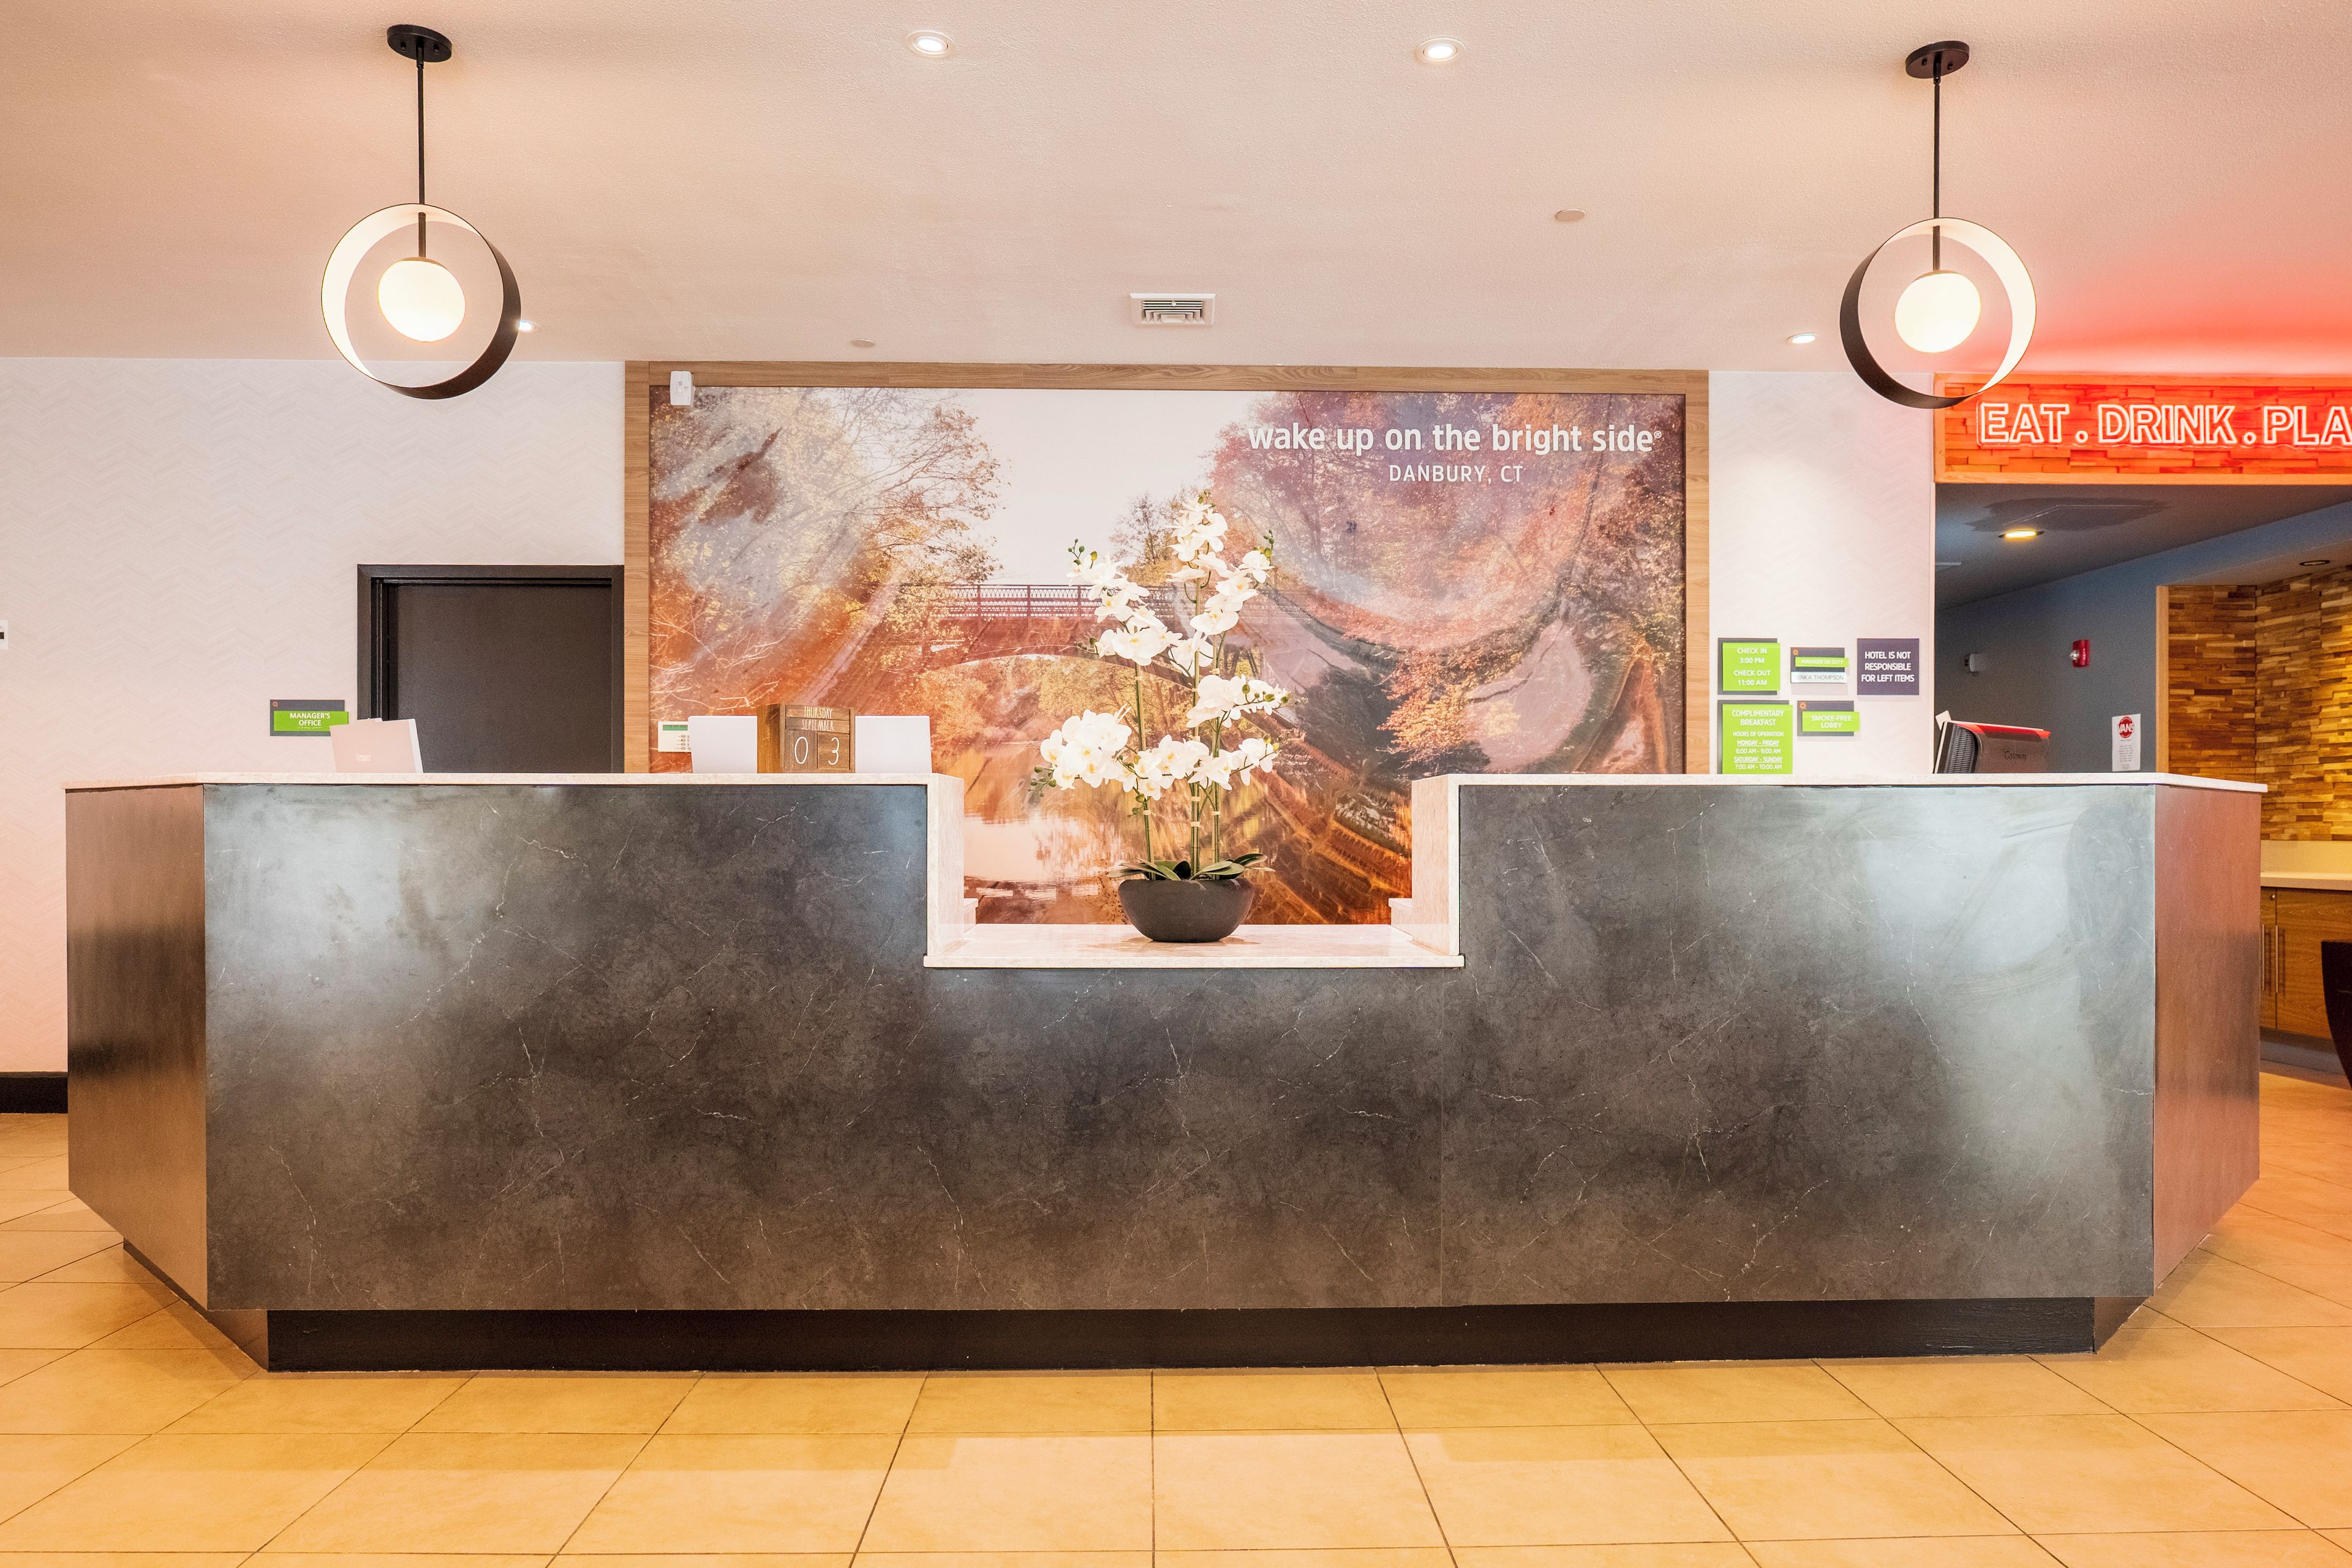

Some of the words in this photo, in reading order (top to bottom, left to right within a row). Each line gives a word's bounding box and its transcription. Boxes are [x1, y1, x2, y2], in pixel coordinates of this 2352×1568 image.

[1248, 422, 1325, 450] wake
[1337, 428, 1374, 456] up
[1385, 428, 1422, 451] on
[1432, 423, 1480, 451] the
[1492, 423, 1582, 456] bright
[2263, 405, 2352, 445] PLA
[1389, 464, 1491, 484] DANBURY,
[1500, 465, 1523, 483] CT
[2117, 723, 2135, 733] VANS
[794, 736, 809, 764] 0
[827, 737, 840, 765] 3
